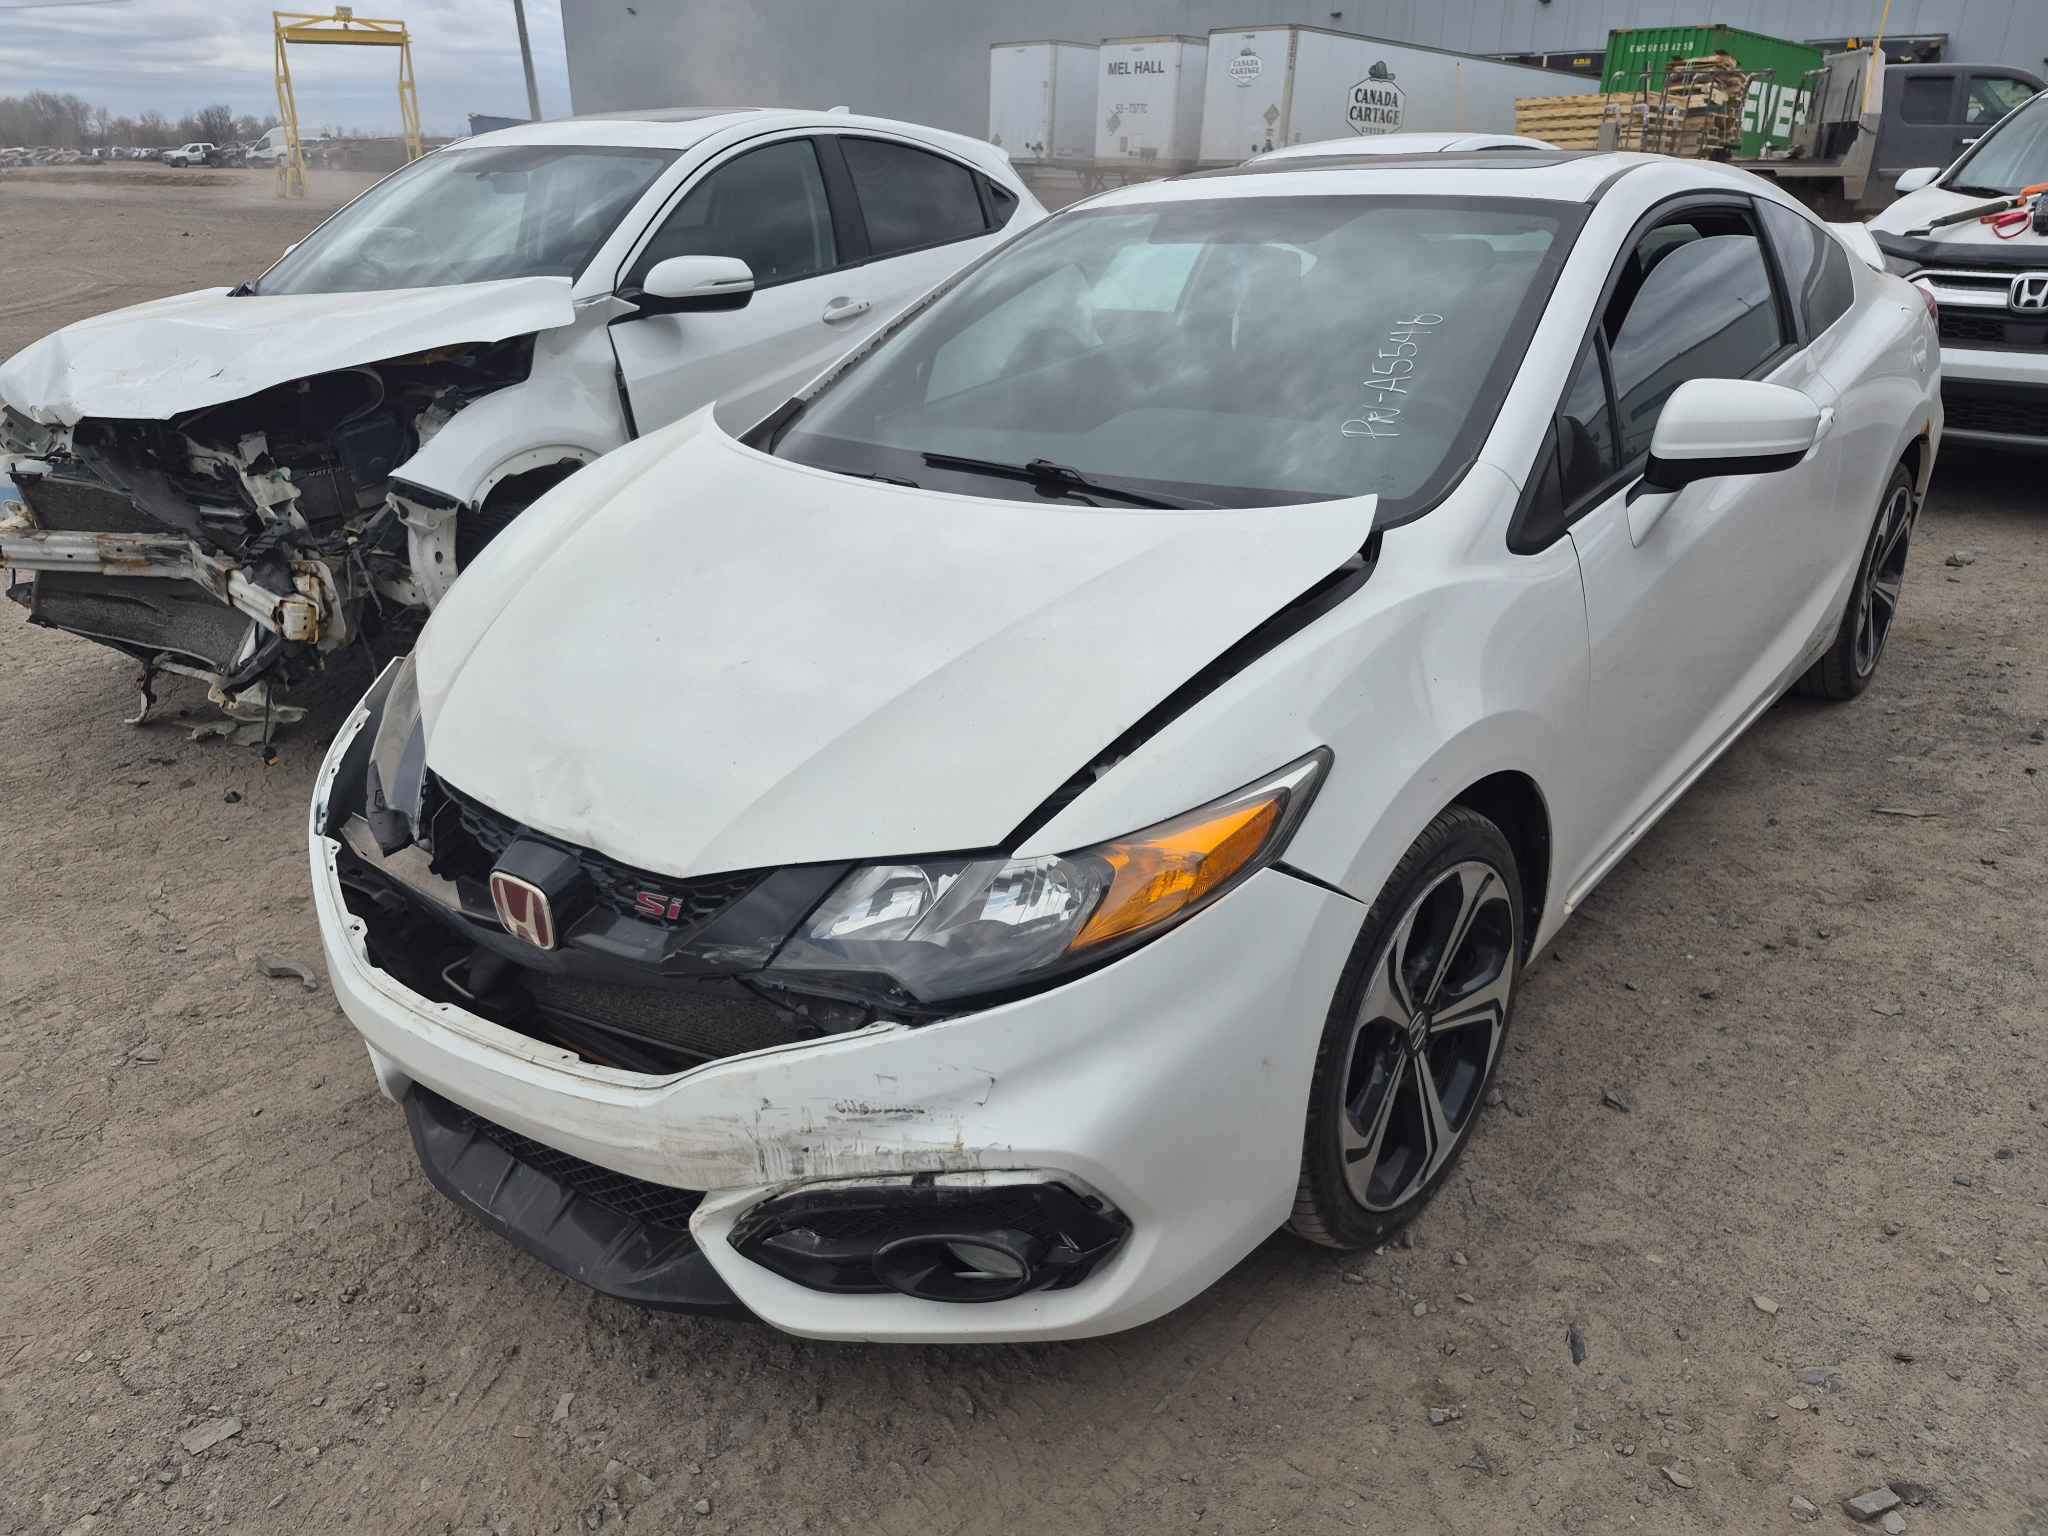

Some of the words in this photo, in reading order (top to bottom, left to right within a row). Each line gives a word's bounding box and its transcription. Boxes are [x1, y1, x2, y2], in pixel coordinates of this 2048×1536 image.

[1108, 61, 1131, 75] MEL
[1134, 61, 1165, 74] HALL
[1355, 88, 1398, 108] CANADA
[1349, 105, 1401, 125] CARTAGE
[633, 891, 683, 920] Si
